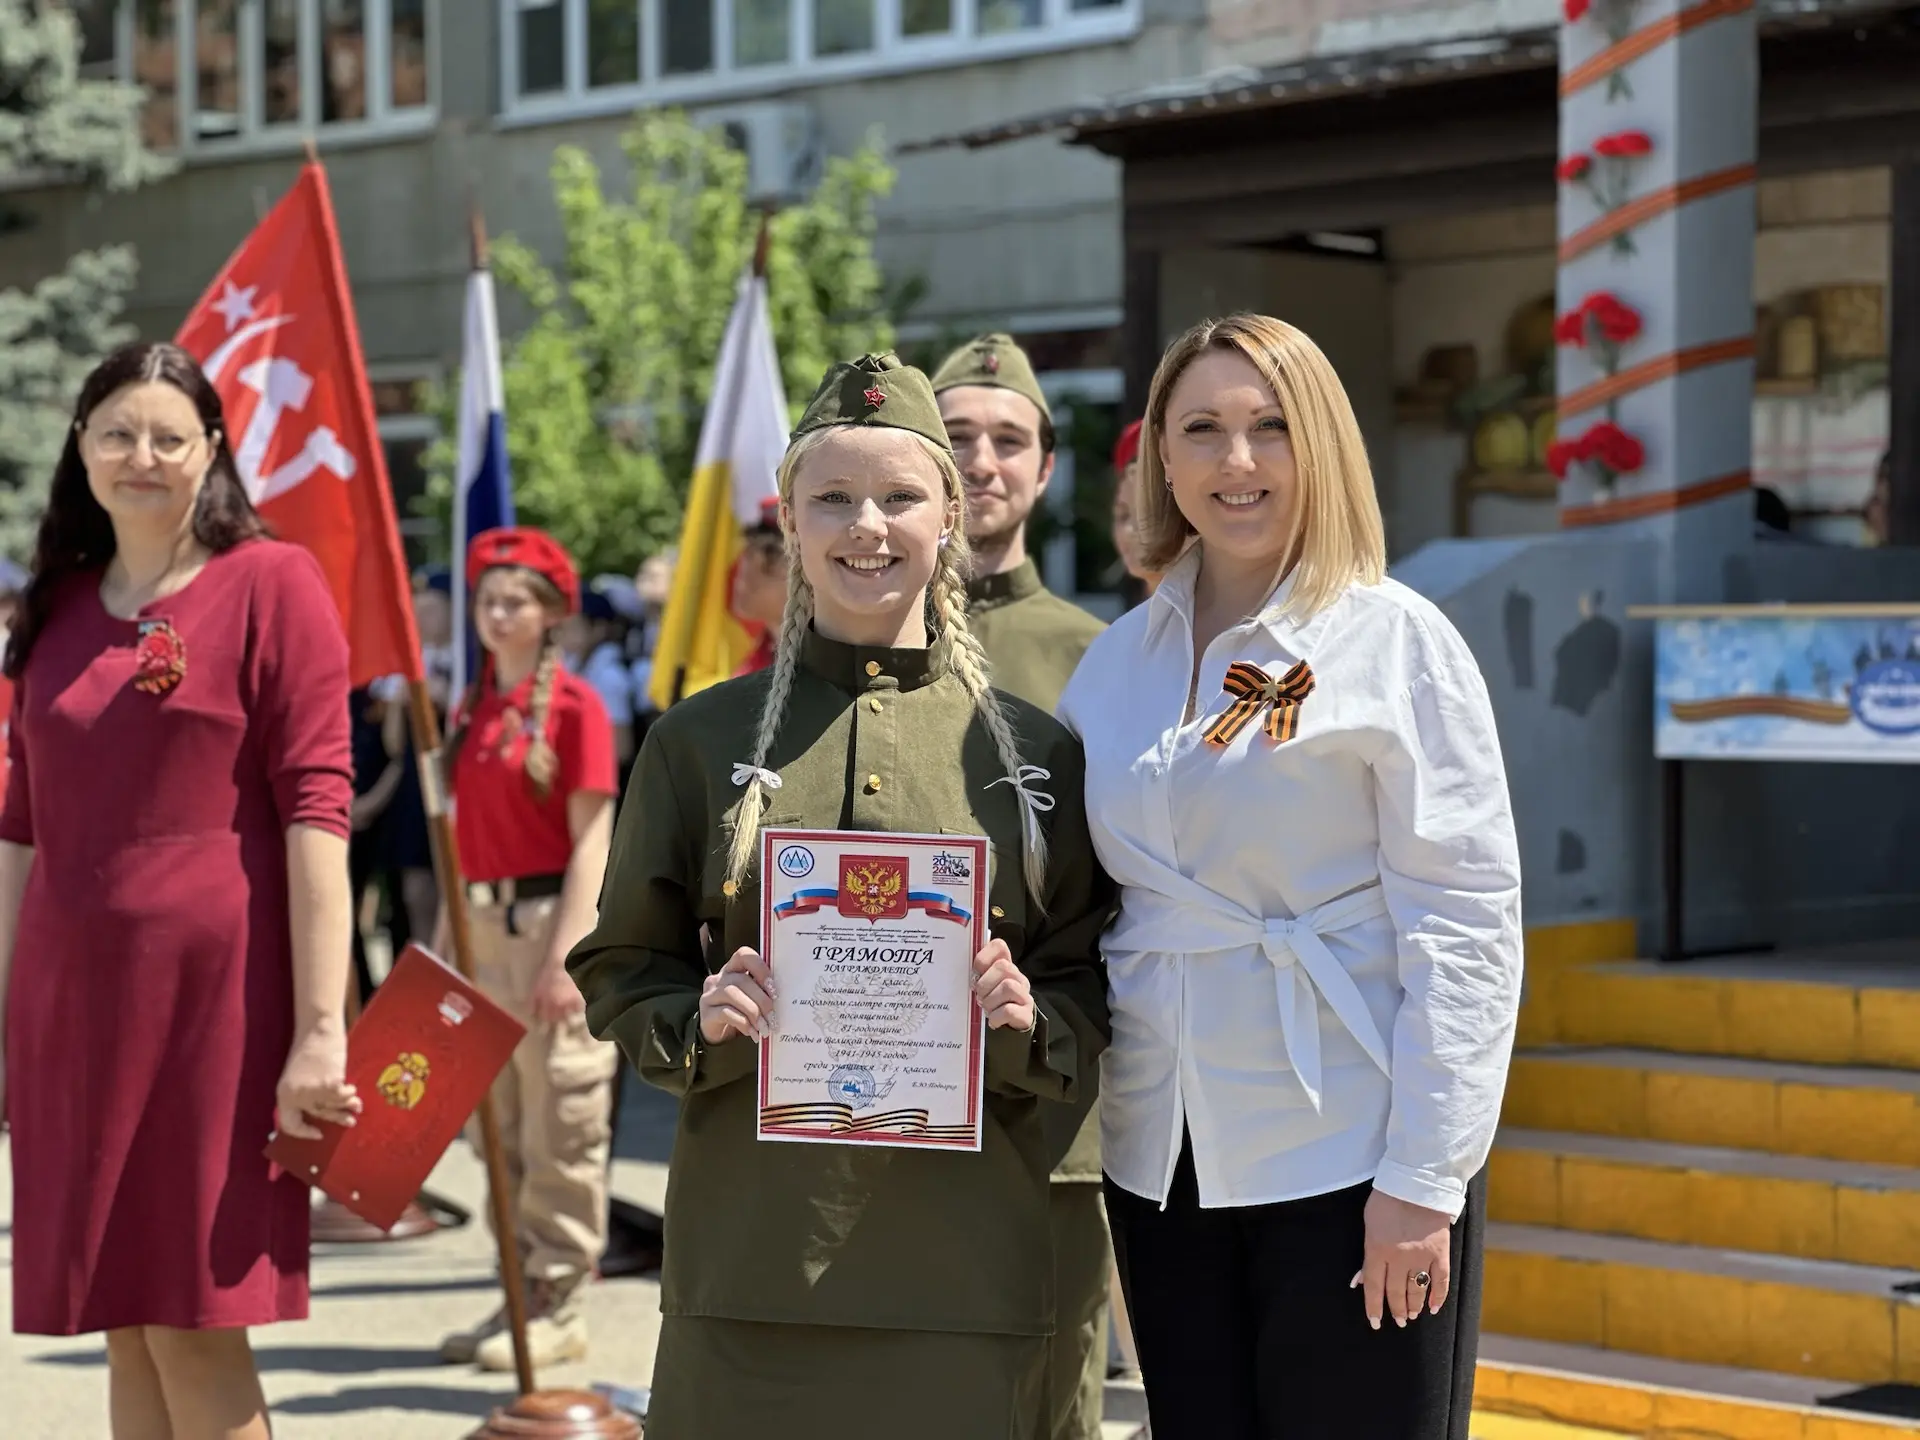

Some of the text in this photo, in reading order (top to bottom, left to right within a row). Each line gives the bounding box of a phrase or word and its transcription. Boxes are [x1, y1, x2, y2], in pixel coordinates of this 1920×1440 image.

[812, 946, 934, 965] ГРАМОТА
[824, 964, 921, 975] НАГРАЖДАЕТСЯ
[848, 1001, 882, 1010] смотре
[839, 1013, 899, 1021] посвященном
[779, 1034, 814, 1044] Победы
[823, 1036, 862, 1046] Великой
[865, 1038, 935, 1048] Отечественной
[834, 1050, 880, 1058] 1941-1945
[804, 1062, 828, 1071] среди
[903, 1066, 936, 1074] классов
